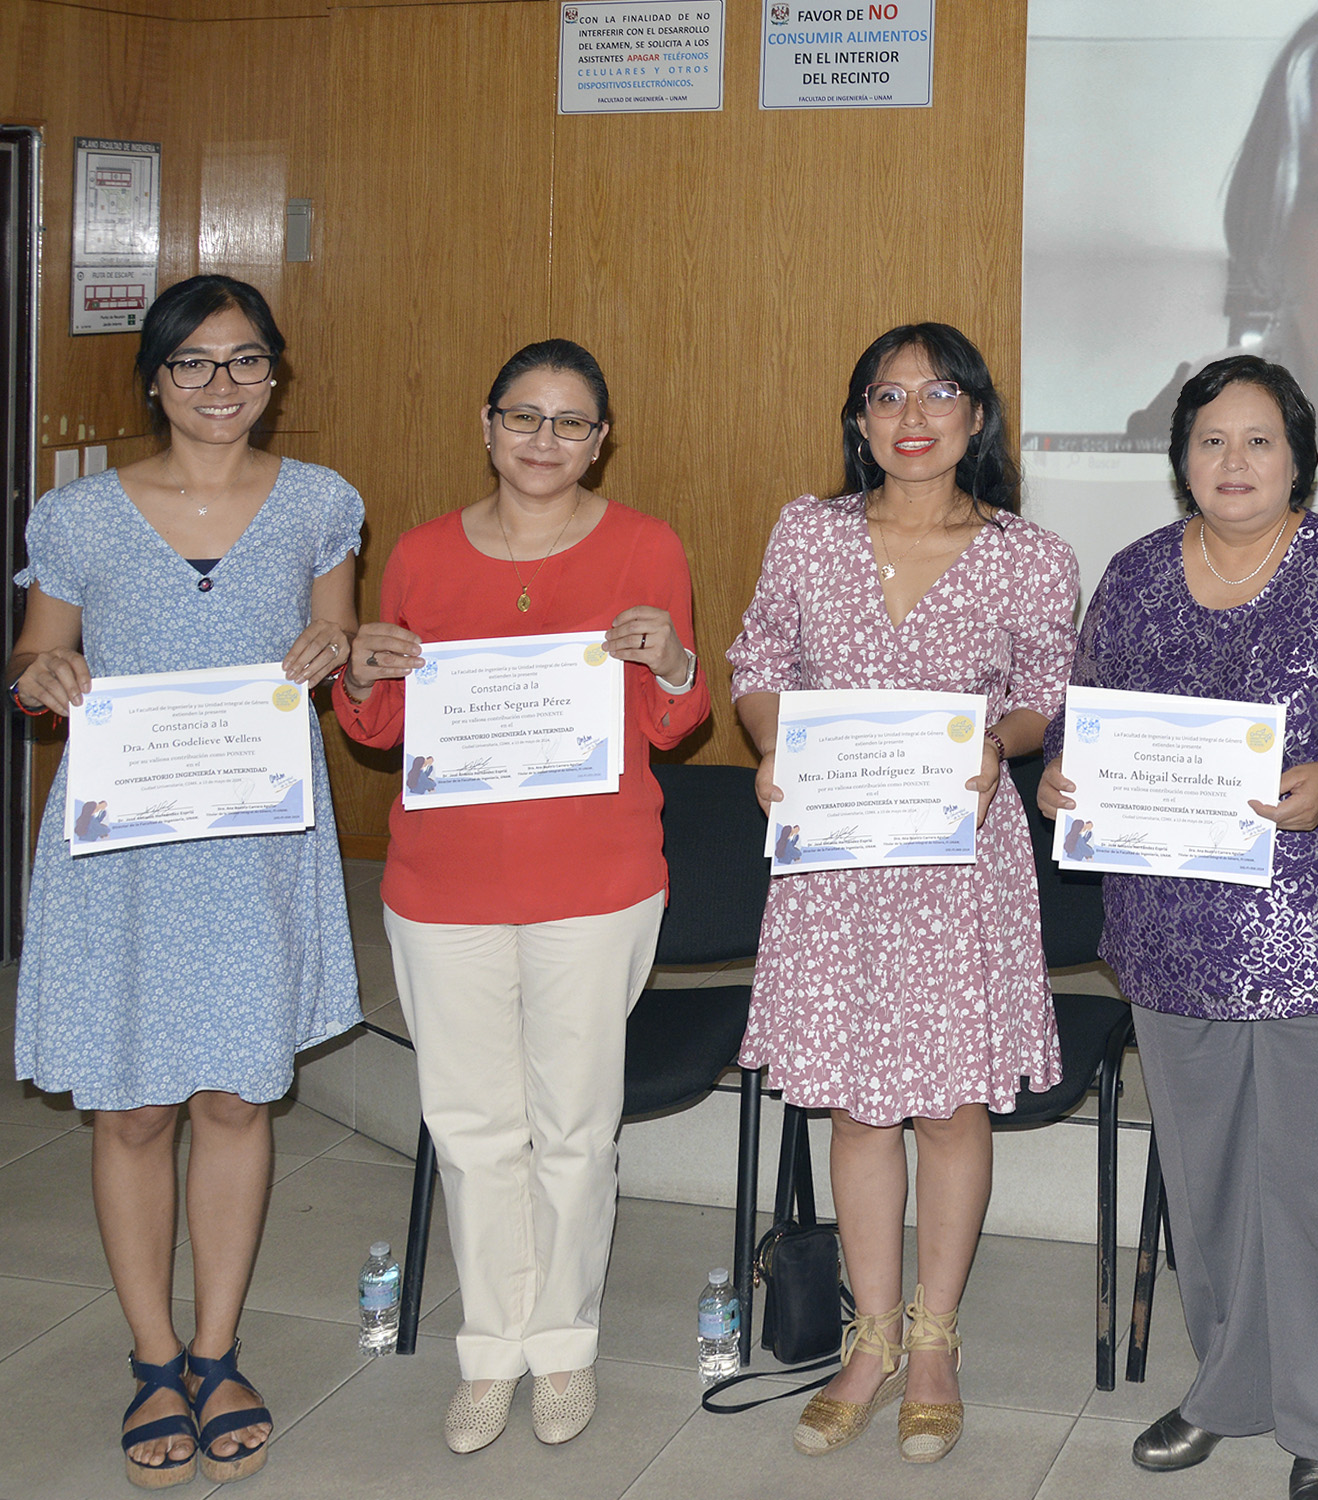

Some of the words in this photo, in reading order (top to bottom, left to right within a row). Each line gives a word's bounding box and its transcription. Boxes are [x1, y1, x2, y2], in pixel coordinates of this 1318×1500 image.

[579, 16, 598, 24] CON
[623, 14, 671, 23] FINALIDAD
[798, 10, 842, 22] FAVOR
[846, 9, 863, 20] DE
[869, 4, 898, 20] NO
[579, 28, 624, 37] INTERFERIR
[647, 27, 655, 35] EL
[658, 26, 709, 34] DESARROLLO
[768, 32, 842, 44] CONSUMIR
[847, 30, 928, 43] ALIMENTOS
[596, 42, 632, 50] EXAMEN,
[648, 40, 682, 48] SOLICITA
[578, 55, 623, 63] ASISTENTES
[663, 52, 709, 60] TELÉFONOS
[795, 53, 812, 64] EN
[817, 53, 830, 63] EL
[835, 51, 899, 63] INTERIOR
[578, 68, 645, 76] CELULARES
[669, 66, 708, 74] OTROS
[578, 81, 631, 89] DISPOSITIVOS
[633, 78, 693, 88] ELECTRÓNICOS.
[803, 73, 827, 85] DEL
[832, 72, 889, 84] RECINTO
[471, 683, 520, 694] Constancia
[531, 681, 539, 689] la
[444, 705, 466, 715] Dra.
[469, 702, 501, 713] Esther
[504, 700, 539, 712] Segura
[543, 697, 571, 706] Pérez
[152, 720, 208, 733] Constancia
[220, 719, 228, 727] la
[123, 743, 144, 753] Dra.
[148, 740, 169, 749] Ann
[172, 737, 221, 747] Godelieve
[224, 735, 261, 744] Wellens
[838, 751, 887, 761] Constancia
[897, 749, 905, 757] la
[1134, 752, 1184, 763] Constancia
[1195, 755, 1203, 764] la
[798, 773, 823, 783] Mtra.
[827, 770, 857, 780] Diana
[861, 767, 915, 779] Rodríguez
[922, 765, 953, 774] Bravo
[1099, 769, 1127, 780] Mtra.
[1130, 771, 1168, 784] Abigail
[1172, 773, 1213, 785] Serralde
[1217, 776, 1242, 787] Ruíz
